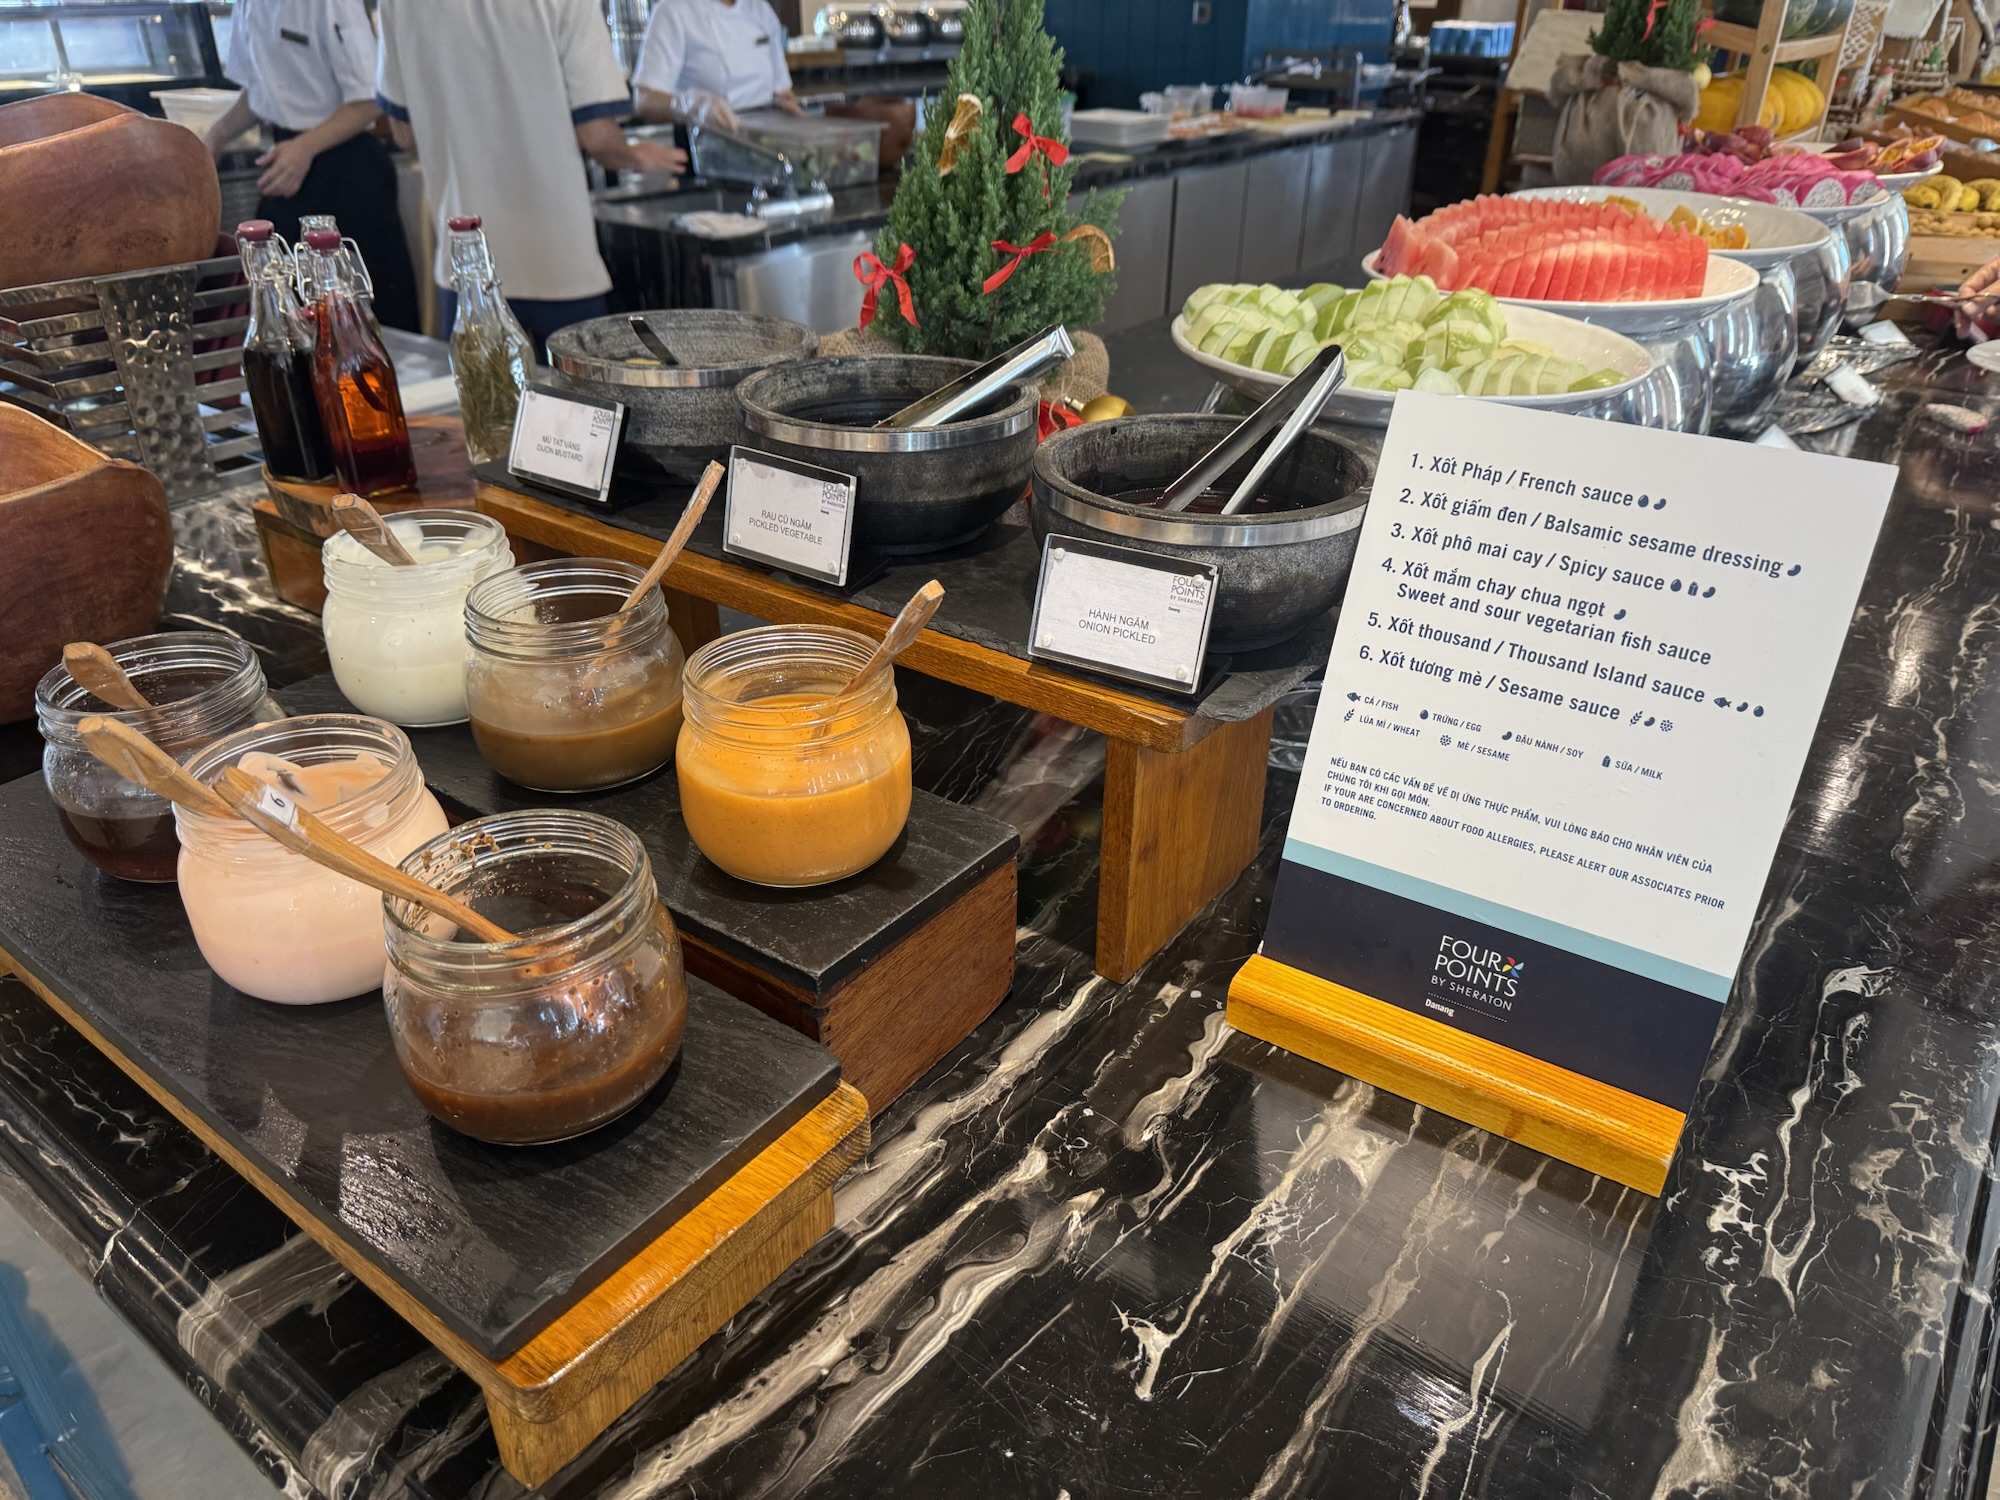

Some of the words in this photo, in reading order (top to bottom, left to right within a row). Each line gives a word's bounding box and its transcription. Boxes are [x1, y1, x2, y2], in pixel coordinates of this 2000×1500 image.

[555, 448, 584, 463] MUSTARD
[1411, 453, 1423, 469] 1.
[1430, 456, 1458, 475] Xốt
[1462, 461, 1502, 485] Pháp
[1505, 470, 1517, 485] /
[1519, 472, 1576, 496] French
[1581, 485, 1633, 507] sauce
[761, 510, 777, 521] RAU
[749, 517, 779, 533] PICKLED
[780, 526, 823, 545] VEGETABLE
[1399, 488, 1414, 504] 2.
[1420, 491, 1447, 510] Xốt
[1450, 499, 1492, 518] giấm
[1497, 506, 1527, 525] đen
[1530, 512, 1542, 527] /
[1544, 514, 1623, 543] Balsamic
[1628, 533, 1696, 558] sesame
[1702, 545, 1783, 579] dressing
[1390, 523, 1405, 539] 3.
[1411, 526, 1438, 545] Xốt
[1441, 533, 1472, 552] phô
[1477, 541, 1508, 558] mai
[1513, 549, 1543, 568] cay
[1545, 553, 1557, 568] /
[1559, 555, 1607, 582] Spicy
[1612, 568, 1665, 591] sauce
[1171, 585, 1206, 600] POINTS
[1382, 557, 1396, 573] 4.
[1402, 560, 1429, 580] Xốt
[1433, 568, 1471, 588] mắm
[1476, 578, 1516, 600] chay
[1521, 587, 1561, 607] chua
[1567, 597, 1606, 618] ngọt
[1078, 619, 1111, 635] ONION
[1113, 626, 1156, 645] PICKLED
[1088, 608, 1116, 623] HÀNH
[1119, 615, 1149, 630] NGÂM
[1397, 583, 1446, 606] Sweet
[1449, 597, 1480, 613] and
[1484, 604, 1521, 622] sour
[1527, 613, 1615, 643] vegetarian
[1620, 631, 1652, 652] fish
[1657, 642, 1711, 665] sauce
[1368, 612, 1382, 628] 5.
[1388, 615, 1414, 635] Xốt
[1418, 624, 1492, 652] thousand
[1493, 640, 1505, 655] /
[1509, 642, 1589, 675] Thousand
[1593, 662, 1647, 689] Island
[1651, 679, 1705, 703] sauce
[1359, 645, 1373, 661] 6.
[1379, 649, 1406, 668] Xốt
[1409, 657, 1454, 683] tương
[1458, 671, 1482, 687] mè
[1485, 675, 1496, 689] /
[1498, 678, 1564, 706] Sesame
[1569, 698, 1620, 720] sauce
[1364, 696, 1374, 705] CÁ
[1381, 700, 1399, 711] FISH
[1393, 723, 1420, 737] WHEAT
[1465, 722, 1482, 732] EGG
[1477, 746, 1510, 761] SESAME
[1566, 747, 1584, 759] SOY
[1327, 770, 1356, 785] CHÚNG
[1359, 779, 1372, 790] TÔI
[1374, 783, 1389, 794] KHI
[1633, 766, 1640, 774] /
[1641, 767, 1663, 780] MILK
[1321, 796, 1332, 806] TO
[1333, 800, 1377, 820] ORDERING.
[1383, 771, 1400, 783] CÁC
[1544, 816, 1561, 829] VUI
[1590, 830, 1610, 843] BÁO
[1612, 836, 1633, 850] CHO
[1635, 843, 1663, 859] NHÂN
[1666, 852, 1689, 866] VIÊN
[1323, 783, 1332, 792] IF
[1334, 786, 1356, 799] YOUR
[1358, 794, 1375, 805] ARE
[1376, 799, 1428, 820] CONCERNED
[1429, 814, 1460, 830] ABOUT
[1461, 823, 1484, 837] FOOD
[1486, 831, 1536, 854] ALLERGIES,
[1539, 846, 1575, 864] PLEASE
[1576, 858, 1607, 873] ALERT
[1608, 867, 1629, 881] OUR
[1631, 874, 1692, 900] ASSOCIATES
[1694, 892, 1725, 910] PRIOR
[1440, 935, 1502, 971] FOUR
[1434, 954, 1518, 997] POINTS
[1431, 975, 1446, 986] BY
[1449, 982, 1512, 1011] SHERATON
[1425, 998, 1455, 1017] Danang
